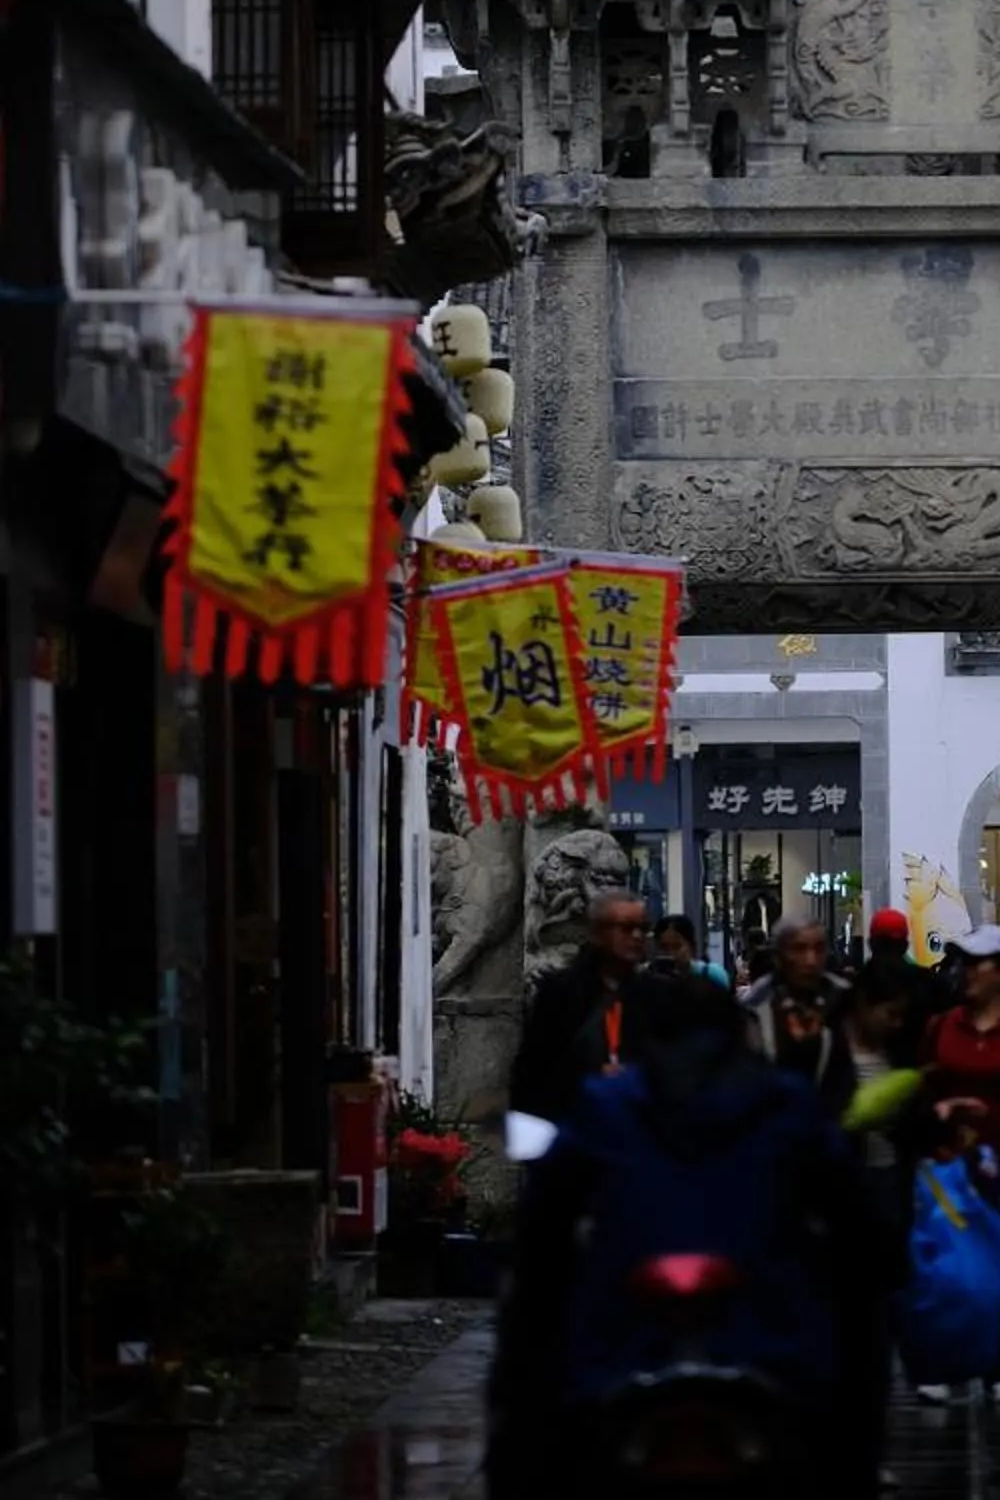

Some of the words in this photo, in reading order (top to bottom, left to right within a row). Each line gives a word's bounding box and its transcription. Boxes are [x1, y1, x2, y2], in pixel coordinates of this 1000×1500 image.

[483, 631, 562, 715] 烟
[585, 586, 639, 721] 黄山烧饼
